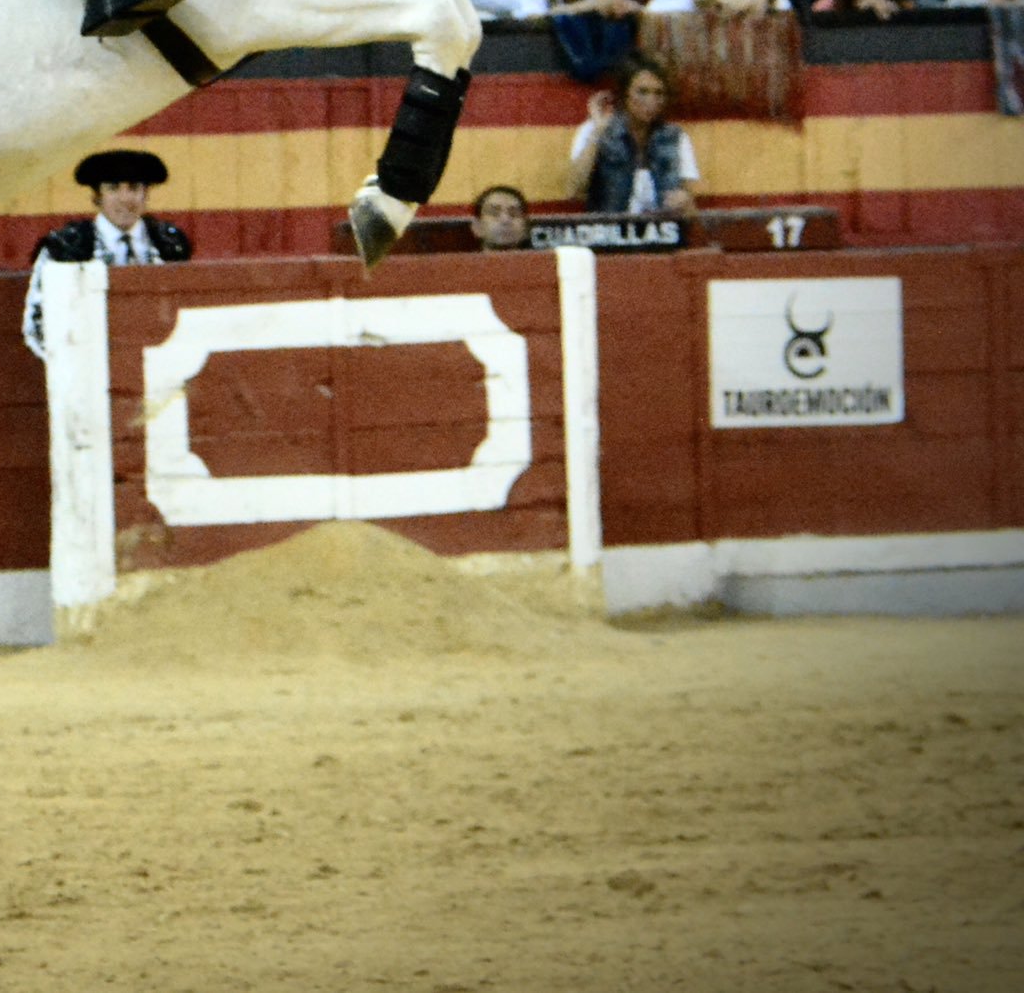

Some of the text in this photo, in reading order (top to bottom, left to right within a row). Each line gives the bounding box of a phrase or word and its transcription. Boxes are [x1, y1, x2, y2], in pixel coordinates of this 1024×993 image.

[529, 221, 680, 249] CUADRILLAS
[766, 215, 806, 249] 17
[724, 381, 892, 416] TAUROEMOCIÓN
